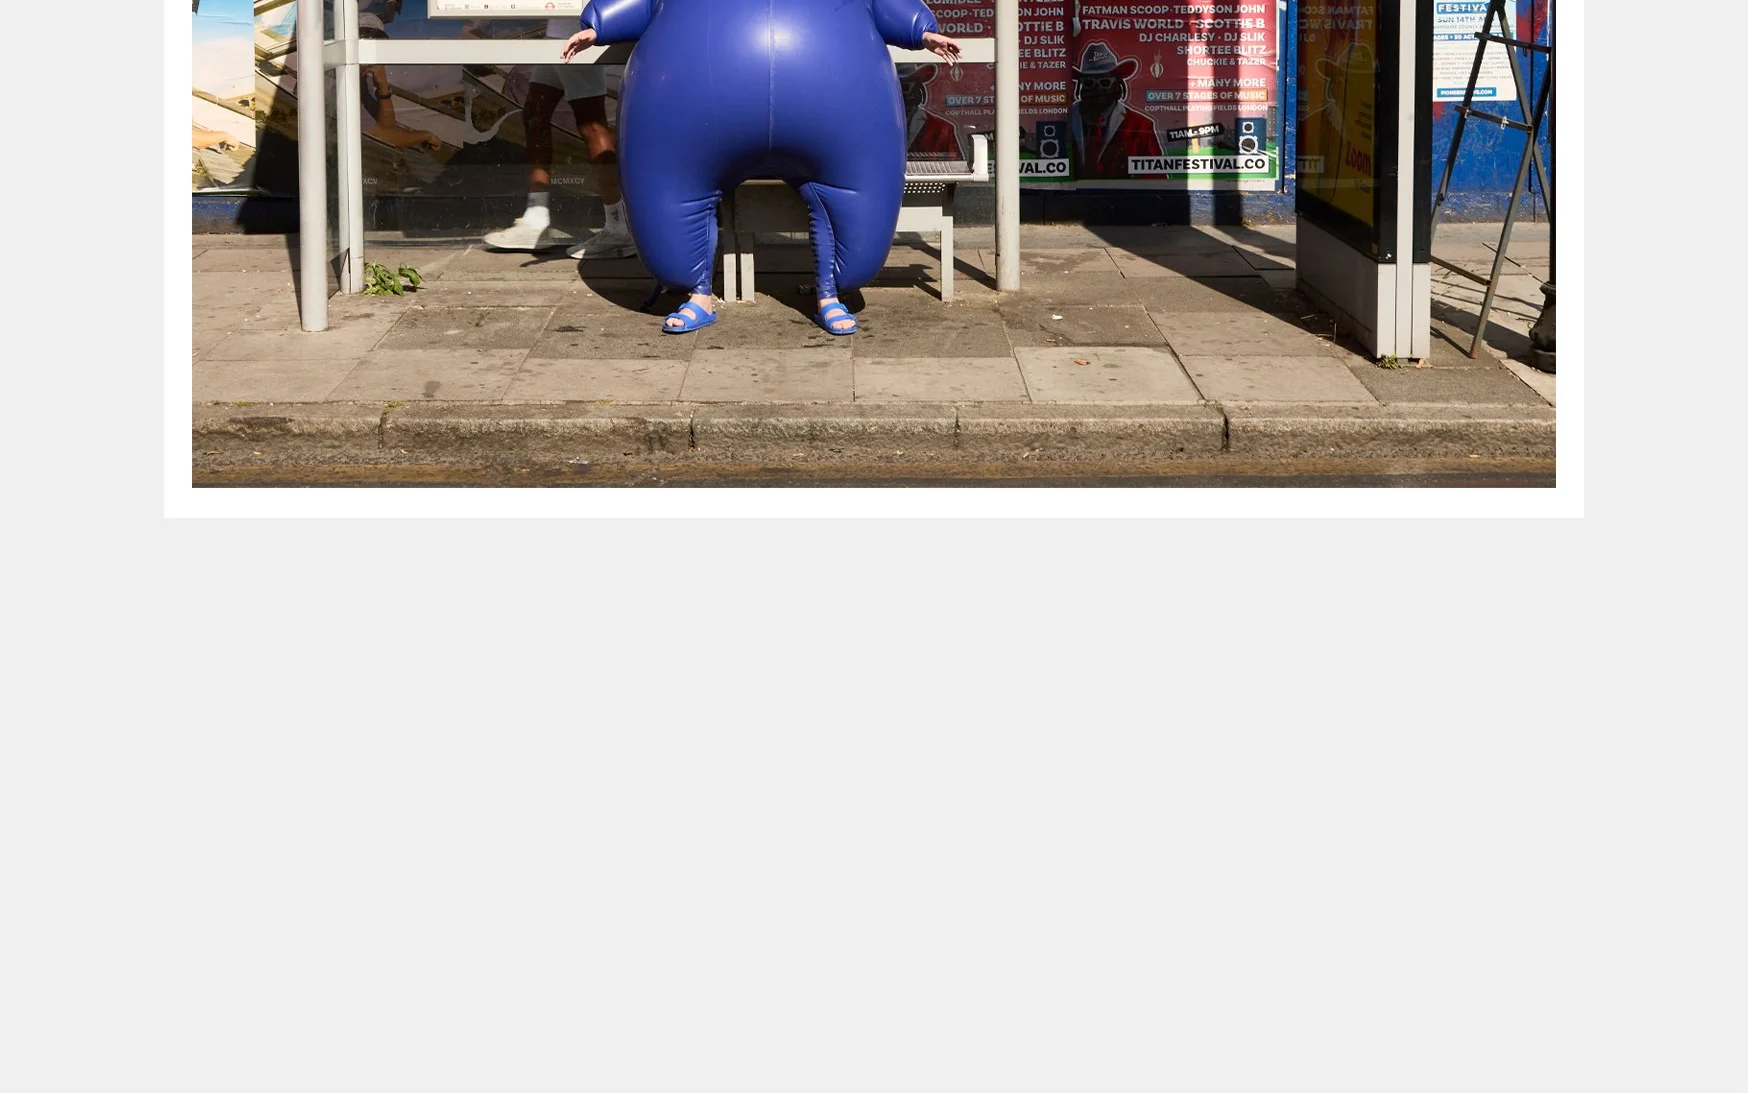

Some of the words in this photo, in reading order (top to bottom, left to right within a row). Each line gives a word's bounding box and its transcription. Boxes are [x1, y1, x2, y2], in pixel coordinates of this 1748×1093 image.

[1034, 8, 1064, 17] JOHN
[1082, 6, 1128, 14] FATMAN
[1130, 6, 1170, 14] SCOOP
[1174, 5, 1232, 14] TEDDYSON
[1234, 4, 1266, 14] JOHN
[1438, 4, 1487, 12] FESTIVA
[1056, 21, 1064, 32] B
[1082, 20, 1132, 30] TRAVIS
[1134, 19, 1184, 30] WORLD
[1196, 18, 1252, 29] SCOTTIE
[1256, 18, 1266, 28] B
[1024, 36, 1038, 45] DJ
[1040, 35, 1064, 44] SLIK
[1139, 33, 1153, 43] DJ
[1155, 32, 1216, 42] CHARLESY
[1224, 32, 1238, 42] DJ
[1240, 32, 1266, 42] SLIK
[1034, 48, 1066, 58] BLITZ
[1176, 45, 1232, 55] SHORTEE
[1234, 45, 1266, 55] BLITZ
[1037, 61, 1066, 69] TAZER
[1186, 58, 1228, 66] CHUCKIE
[1236, 58, 1266, 66] TAZER
[1034, 82, 1066, 90] MORE
[1198, 78, 1231, 88] MANY
[1233, 78, 1266, 87] MORE
[950, 96, 973, 104] OVER
[975, 96, 981, 104] 7
[1021, 95, 1034, 103] OF
[1035, 94, 1066, 103] MUSIC
[1148, 92, 1173, 100] OVER
[1175, 92, 1181, 100] 7
[1183, 92, 1218, 100] STAGES
[1220, 92, 1232, 100] OF
[1234, 92, 1266, 100] MUSIC
[1199, 125, 1220, 135] 9PM
[1132, 158, 1266, 170] TITANFESTIVAL.CO
